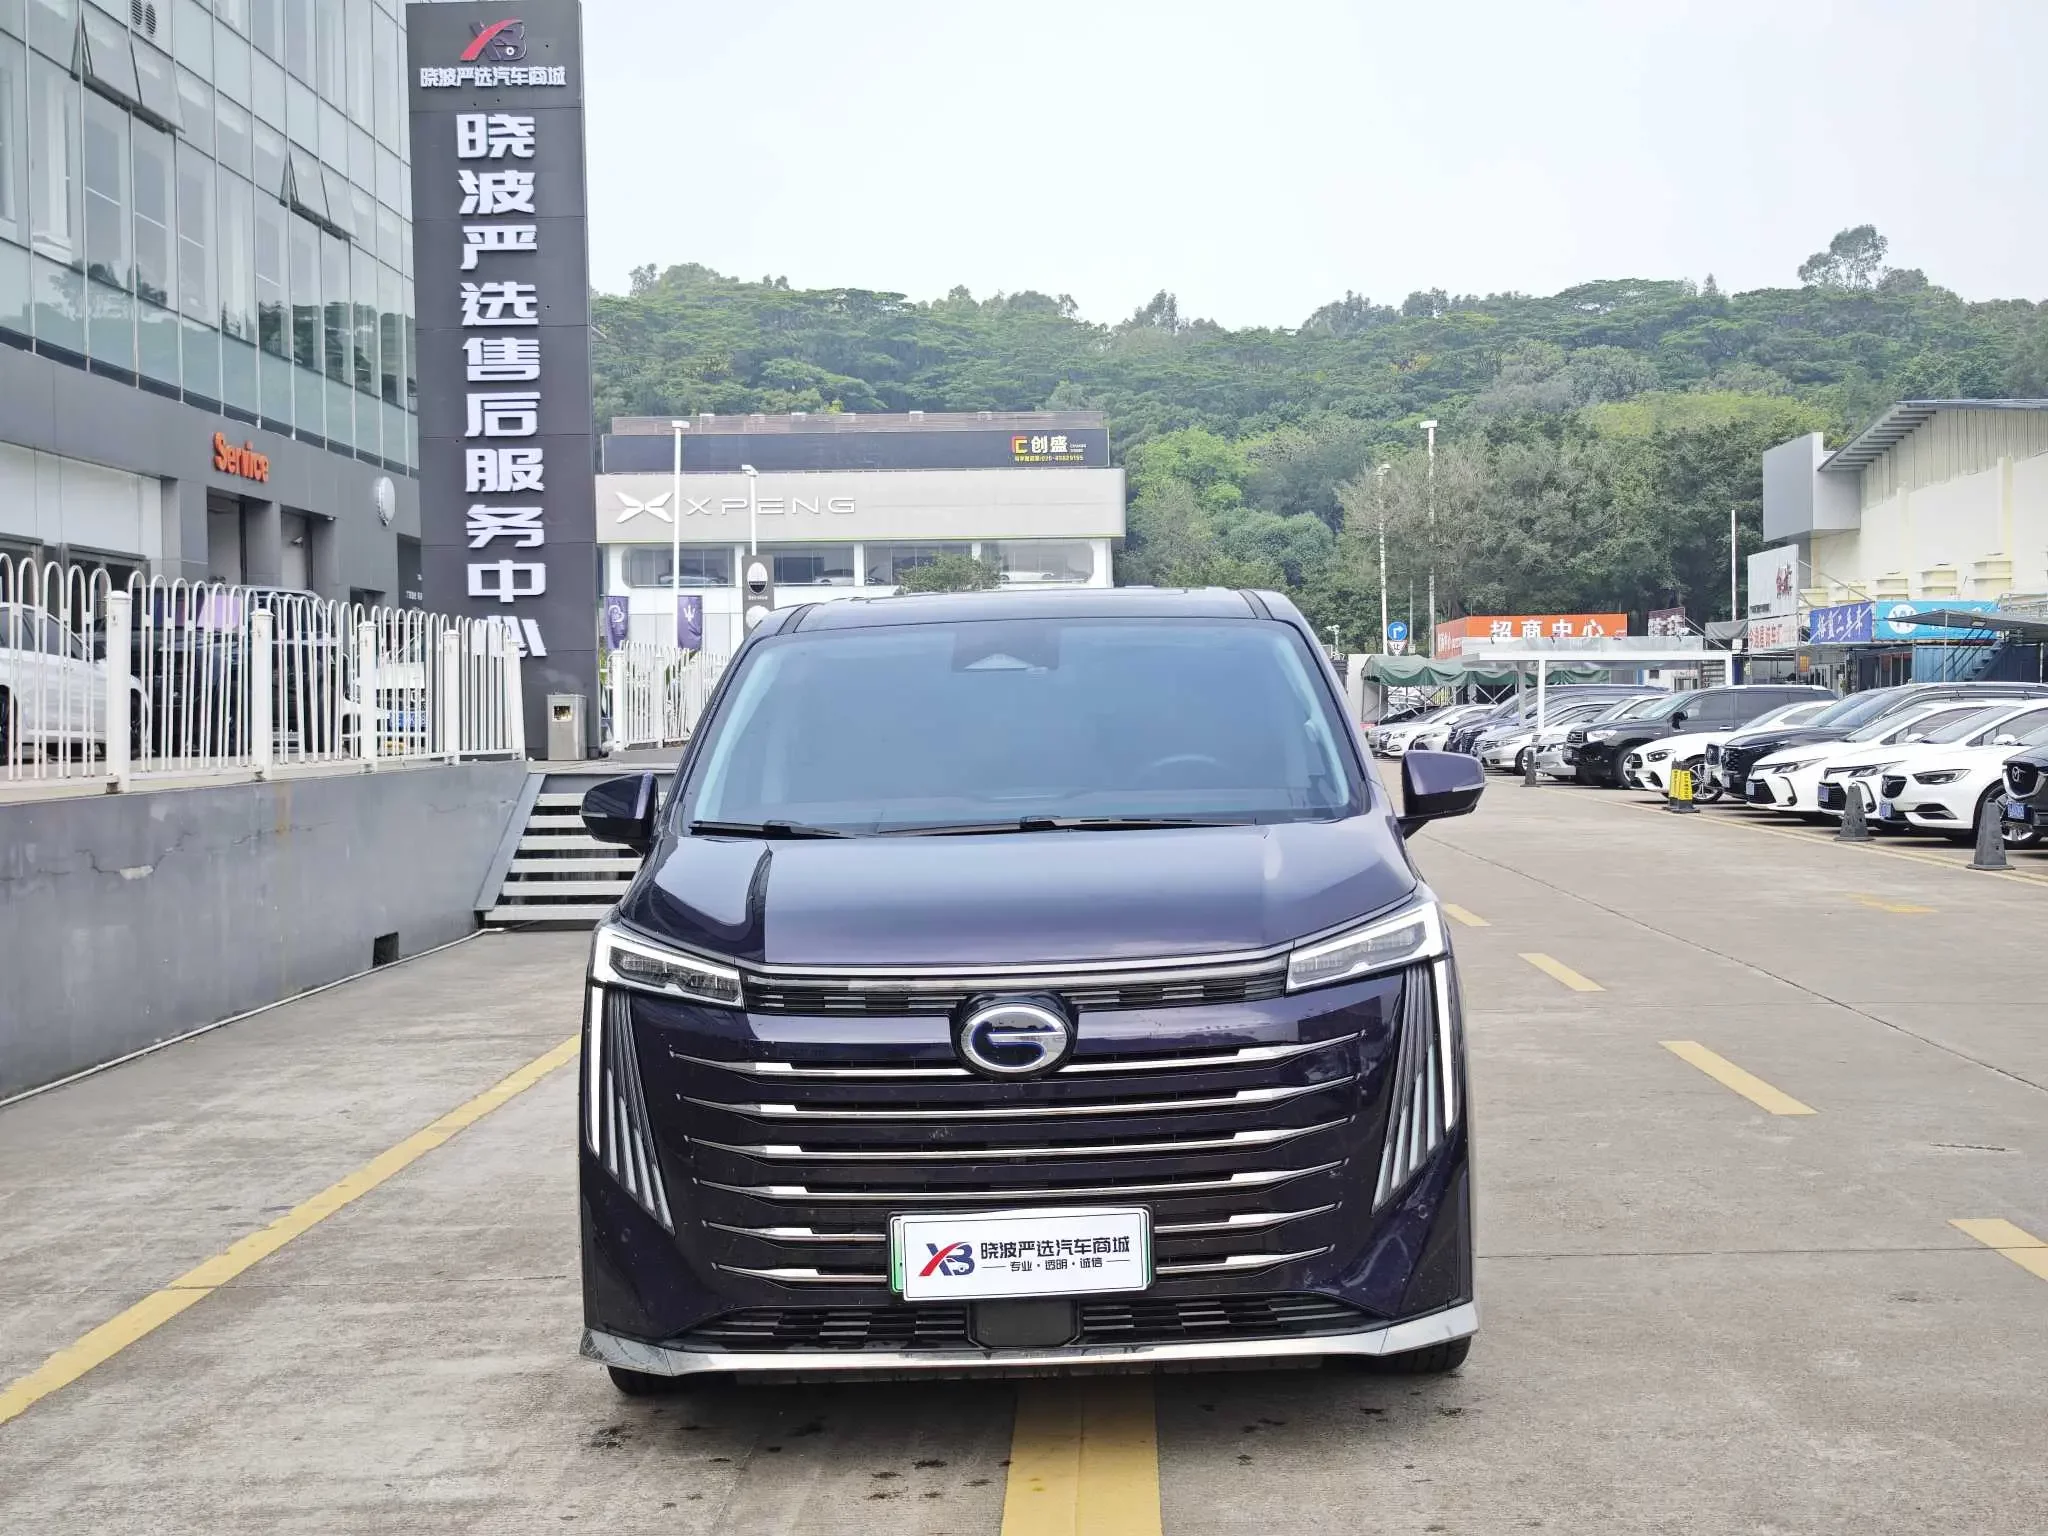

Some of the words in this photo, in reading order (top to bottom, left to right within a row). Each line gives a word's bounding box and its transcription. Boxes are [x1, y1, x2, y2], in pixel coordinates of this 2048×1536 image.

[420, 66, 567, 88] 晓波严选汽车商城
[1031, 434, 1068, 454] 创盛
[212, 432, 270, 483] Service
[686, 496, 857, 516] XPENG
[1490, 618, 1604, 639] 招商中心
[980, 1235, 1131, 1260] 晓波严选汽车商城
